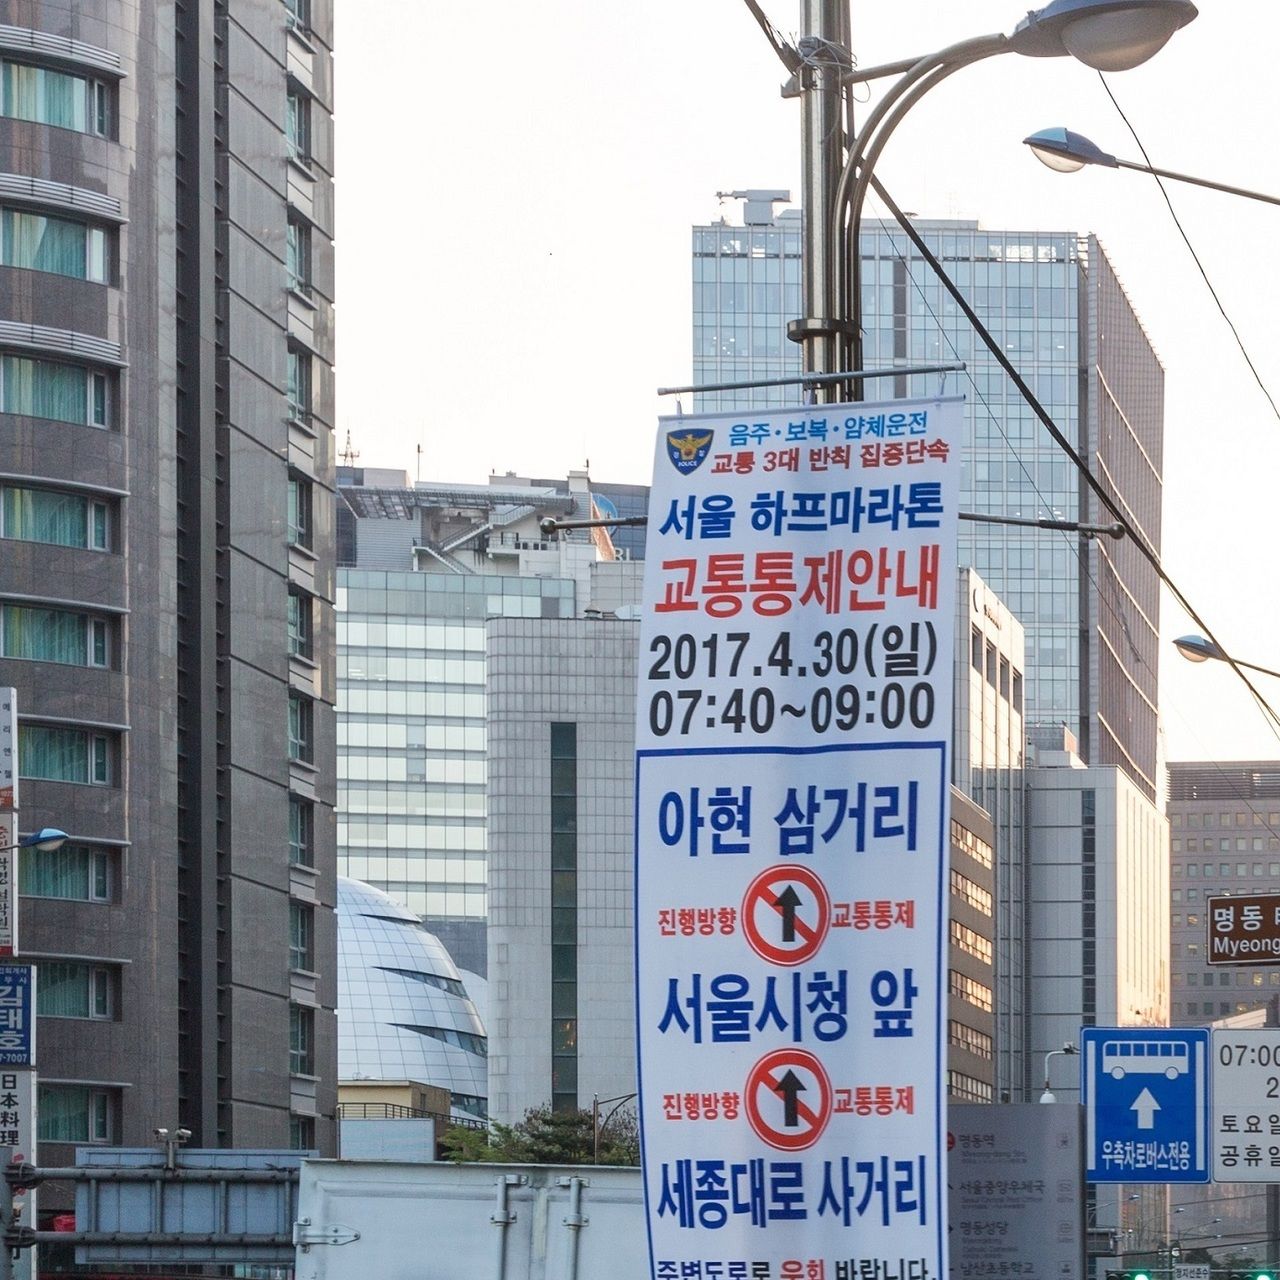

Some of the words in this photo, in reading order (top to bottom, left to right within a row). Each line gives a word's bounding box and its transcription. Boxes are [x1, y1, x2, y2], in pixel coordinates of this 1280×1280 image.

[711, 452, 755, 473] 교통
[763, 451, 799, 473] 3대
[809, 446, 851, 471] 반칙
[860, 439, 949, 467] 집중단속
[659, 494, 737, 540] 서울
[751, 482, 944, 536] 하프마라톤
[655, 544, 940, 618] 교통통제안내
[648, 621, 937, 680] 2017.4.30(일)
[650, 682, 935, 736] 07:40~09:00
[658, 786, 752, 856] 아현
[774, 781, 918, 856] 삼거리
[658, 907, 737, 936] 진행방향
[831, 900, 914, 929] 교통통제
[1214, 905, 1263, 932] 명동
[658, 970, 848, 1043] 서울시청
[870, 968, 918, 1037] 앞
[0, 1074, 20, 1146] 日本料理
[663, 1092, 740, 1121] 진행방향
[834, 1086, 914, 1115] 교통통제
[960, 1134, 995, 1149] 명동역
[1101, 1140, 1191, 1171] 우측차로버스전용
[657, 1158, 807, 1229] 세종대로
[818, 1155, 927, 1226] 사거리
[960, 1180, 1046, 1195] 서울중앙우체국
[960, 1220, 1008, 1235] 명동성당
[960, 1262, 1035, 1276] 남산초등학교
